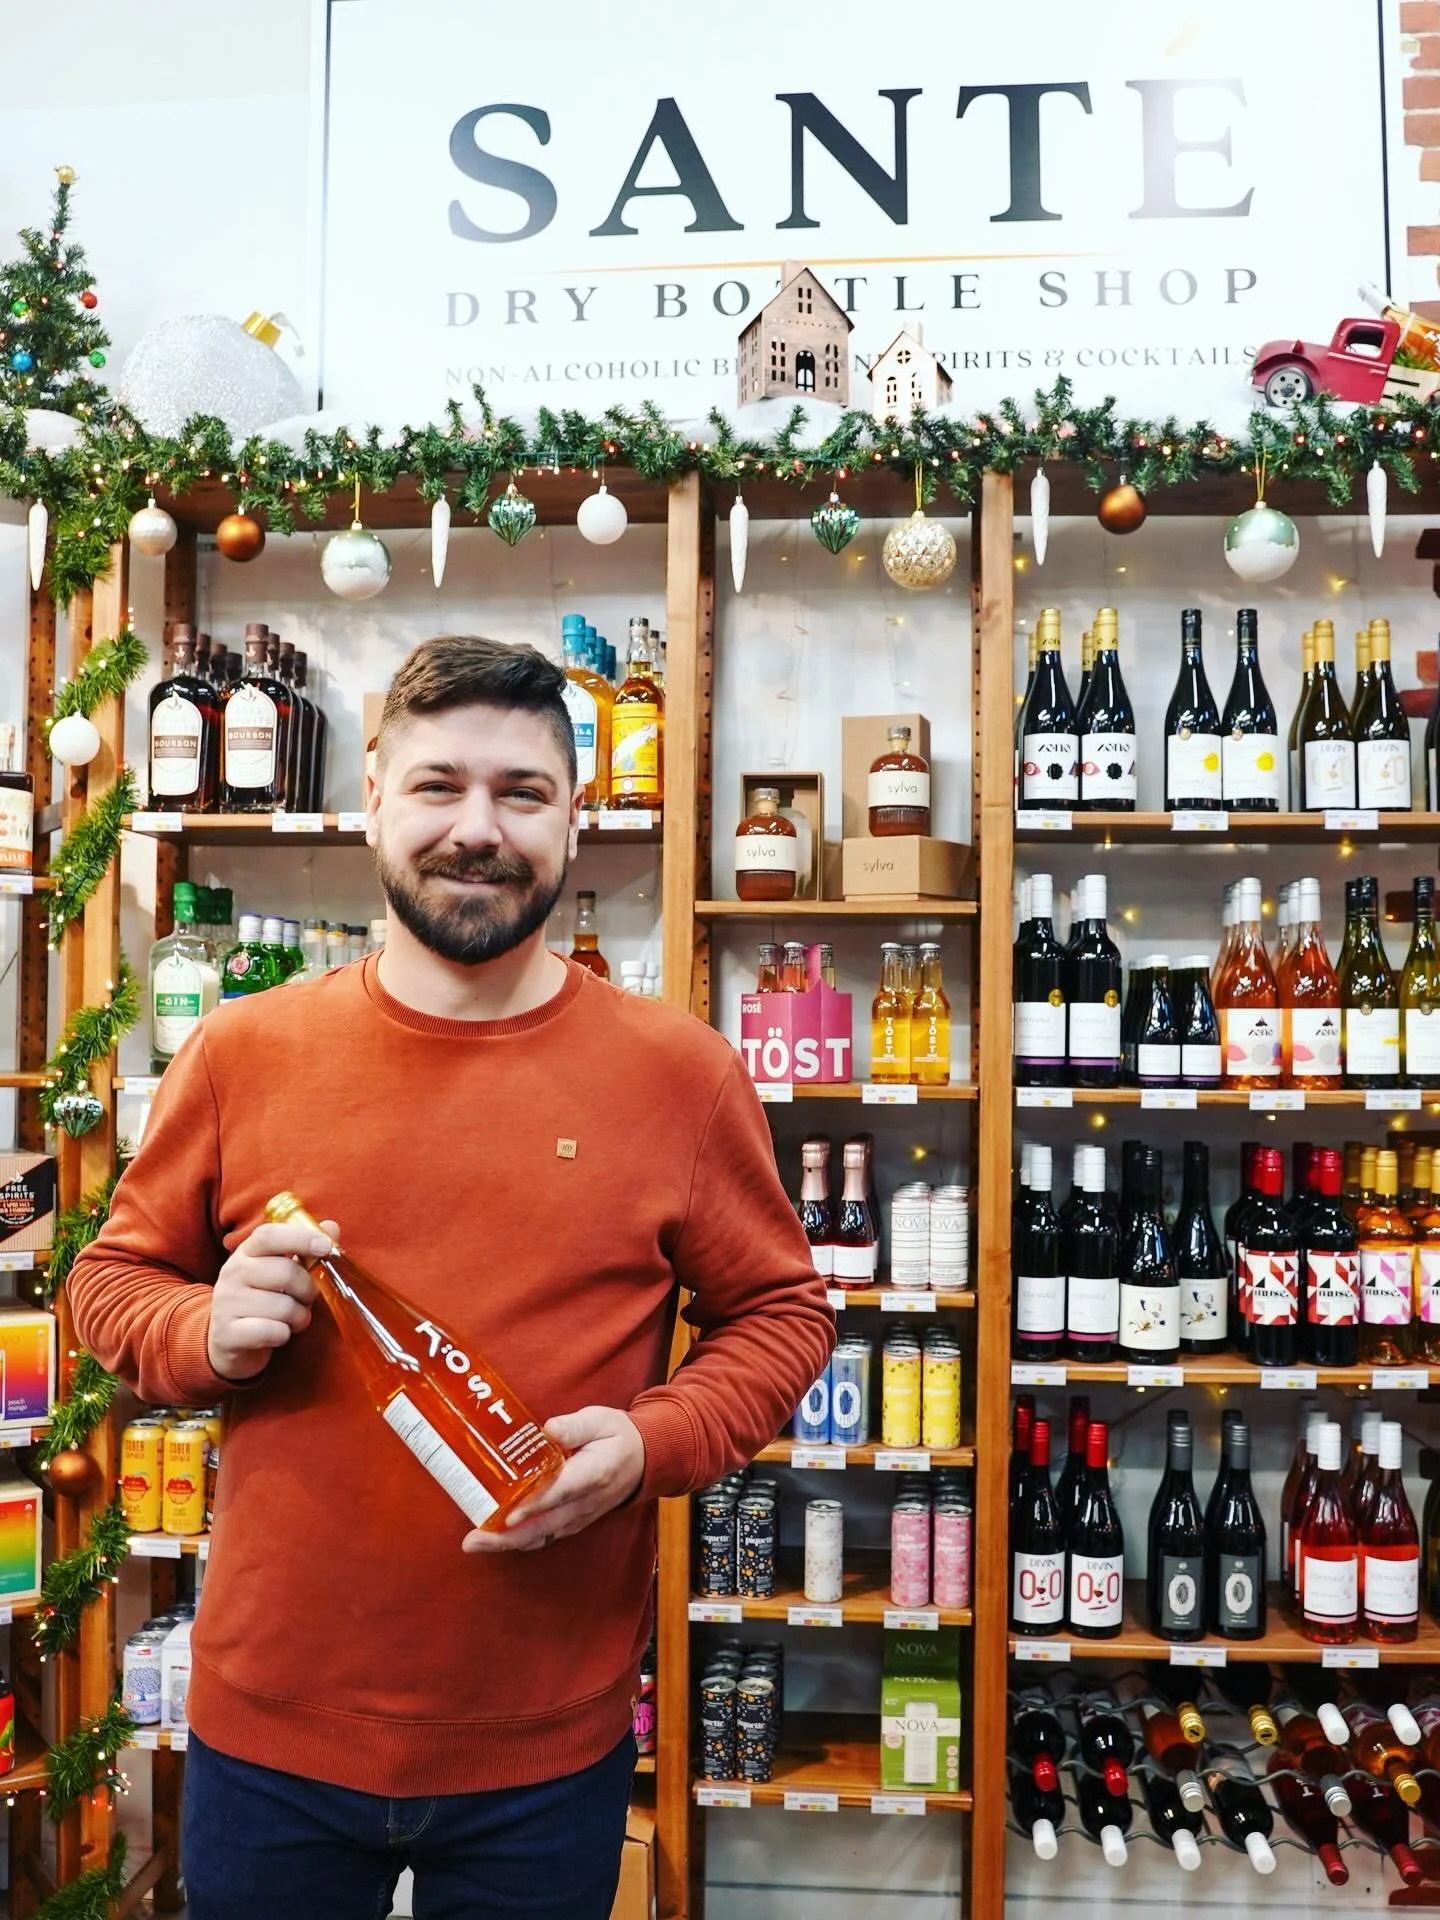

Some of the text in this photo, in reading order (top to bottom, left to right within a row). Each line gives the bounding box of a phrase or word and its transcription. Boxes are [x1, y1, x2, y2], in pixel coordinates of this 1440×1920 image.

[445, 268, 1258, 327] DRY BOTLE SHOP
[445, 357, 702, 387] NON-ALCOHOLIC
[1076, 345, 1258, 368] COCKTAILS
[228, 731, 272, 741] BOURBON
[155, 739, 197, 749] BOURBON
[888, 783, 918, 794] sylva
[746, 846, 776, 857] sylva
[863, 858, 894, 871] sylva
[164, 997, 189, 1006] GIN
[742, 1000, 762, 1014] ROSÉ
[884, 1016, 895, 1054] TÖST
[928, 1015, 938, 1053] TÖST
[742, 1027, 850, 1078] TÖST
[5, 1184, 28, 1192] FREE
[414, 1320, 513, 1425] TÖST
[896, 1643, 938, 1655] NOVA
[895, 1719, 938, 1732] NOVA
